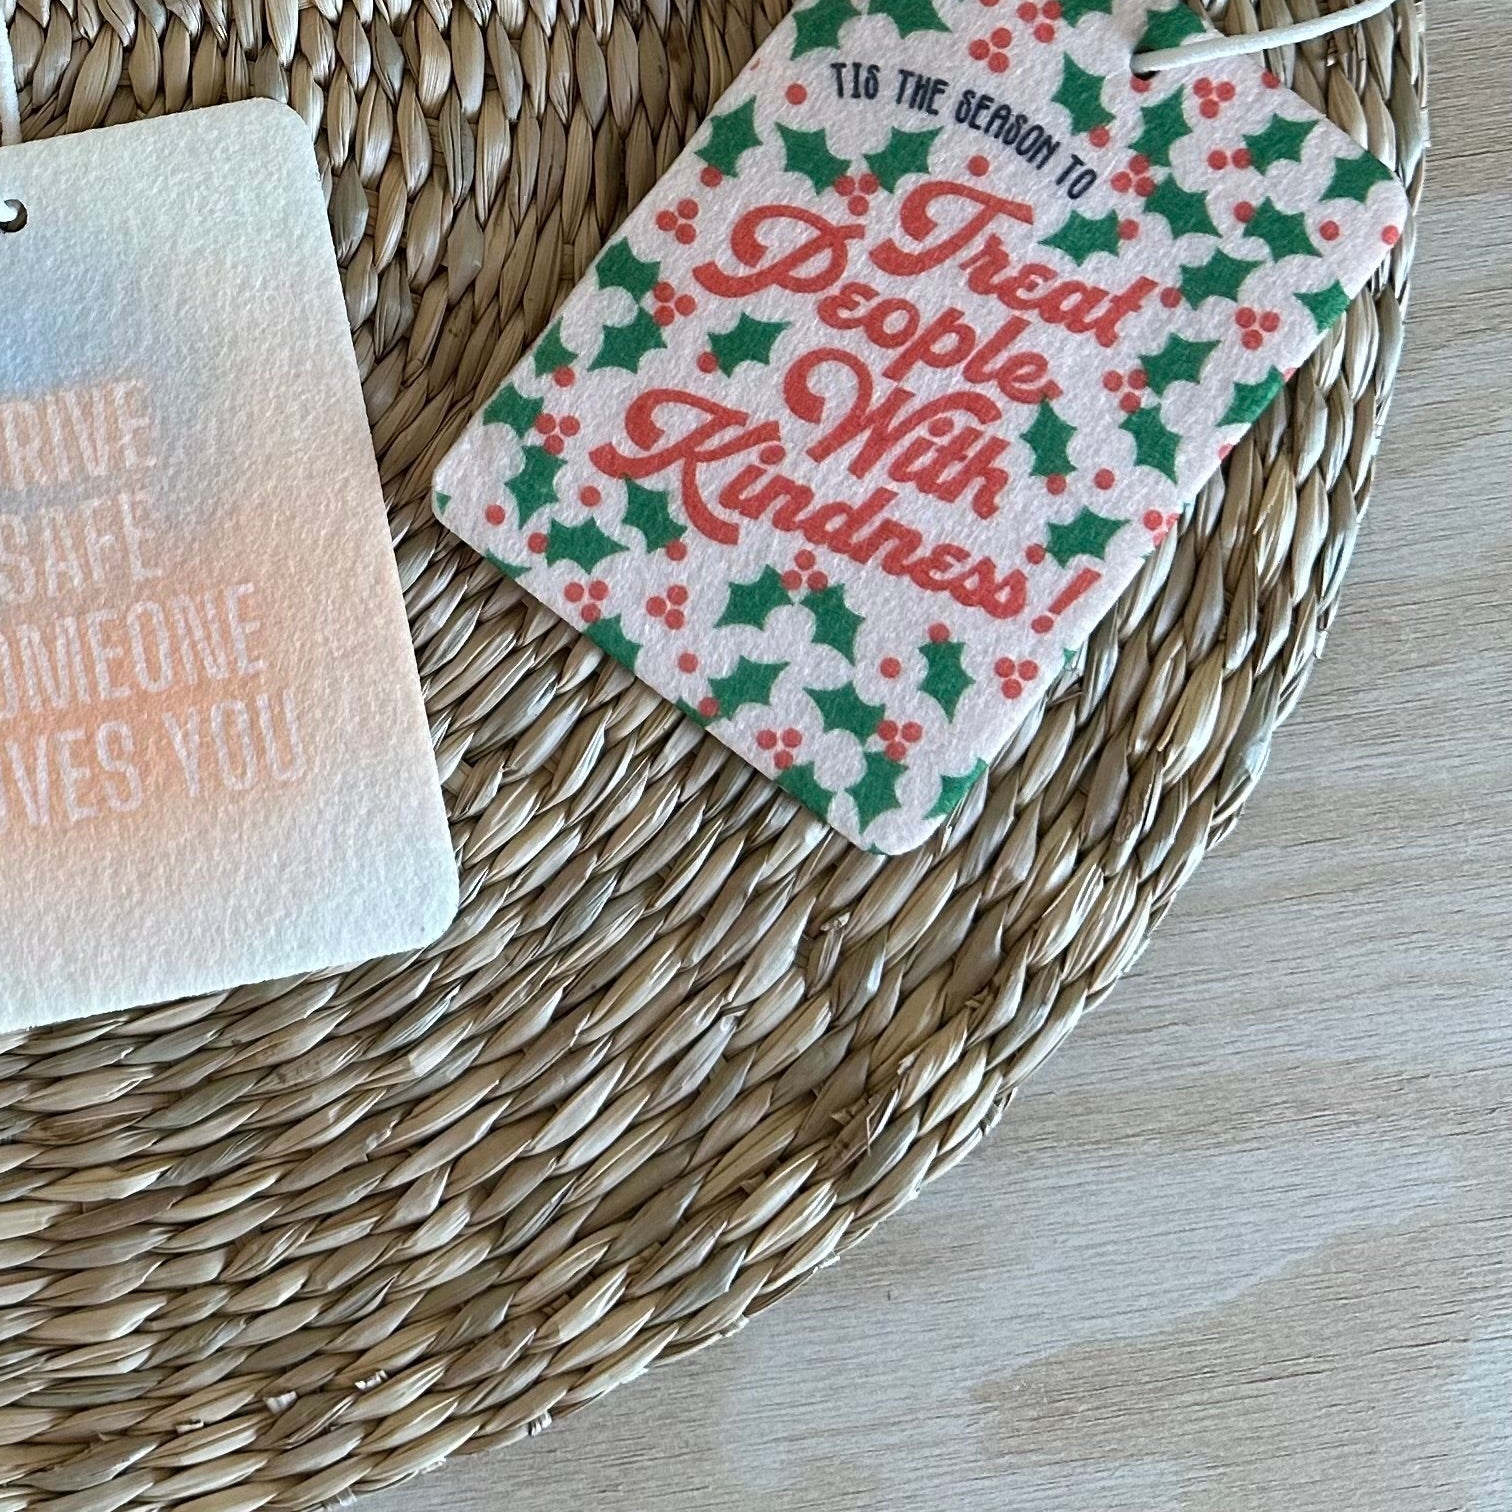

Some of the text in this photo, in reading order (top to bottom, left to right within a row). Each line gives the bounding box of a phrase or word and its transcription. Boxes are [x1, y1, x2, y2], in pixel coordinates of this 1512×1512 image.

[898, 70, 950, 115] THE
[955, 90, 1059, 169] SEASON
[1056, 158, 1098, 199] TO
[692, 205, 1062, 402] People
[869, 181, 1158, 347] Treat
[589, 389, 1100, 635] Kindness!
[782, 348, 1010, 519] With
[161, 691, 306, 795] YOU
